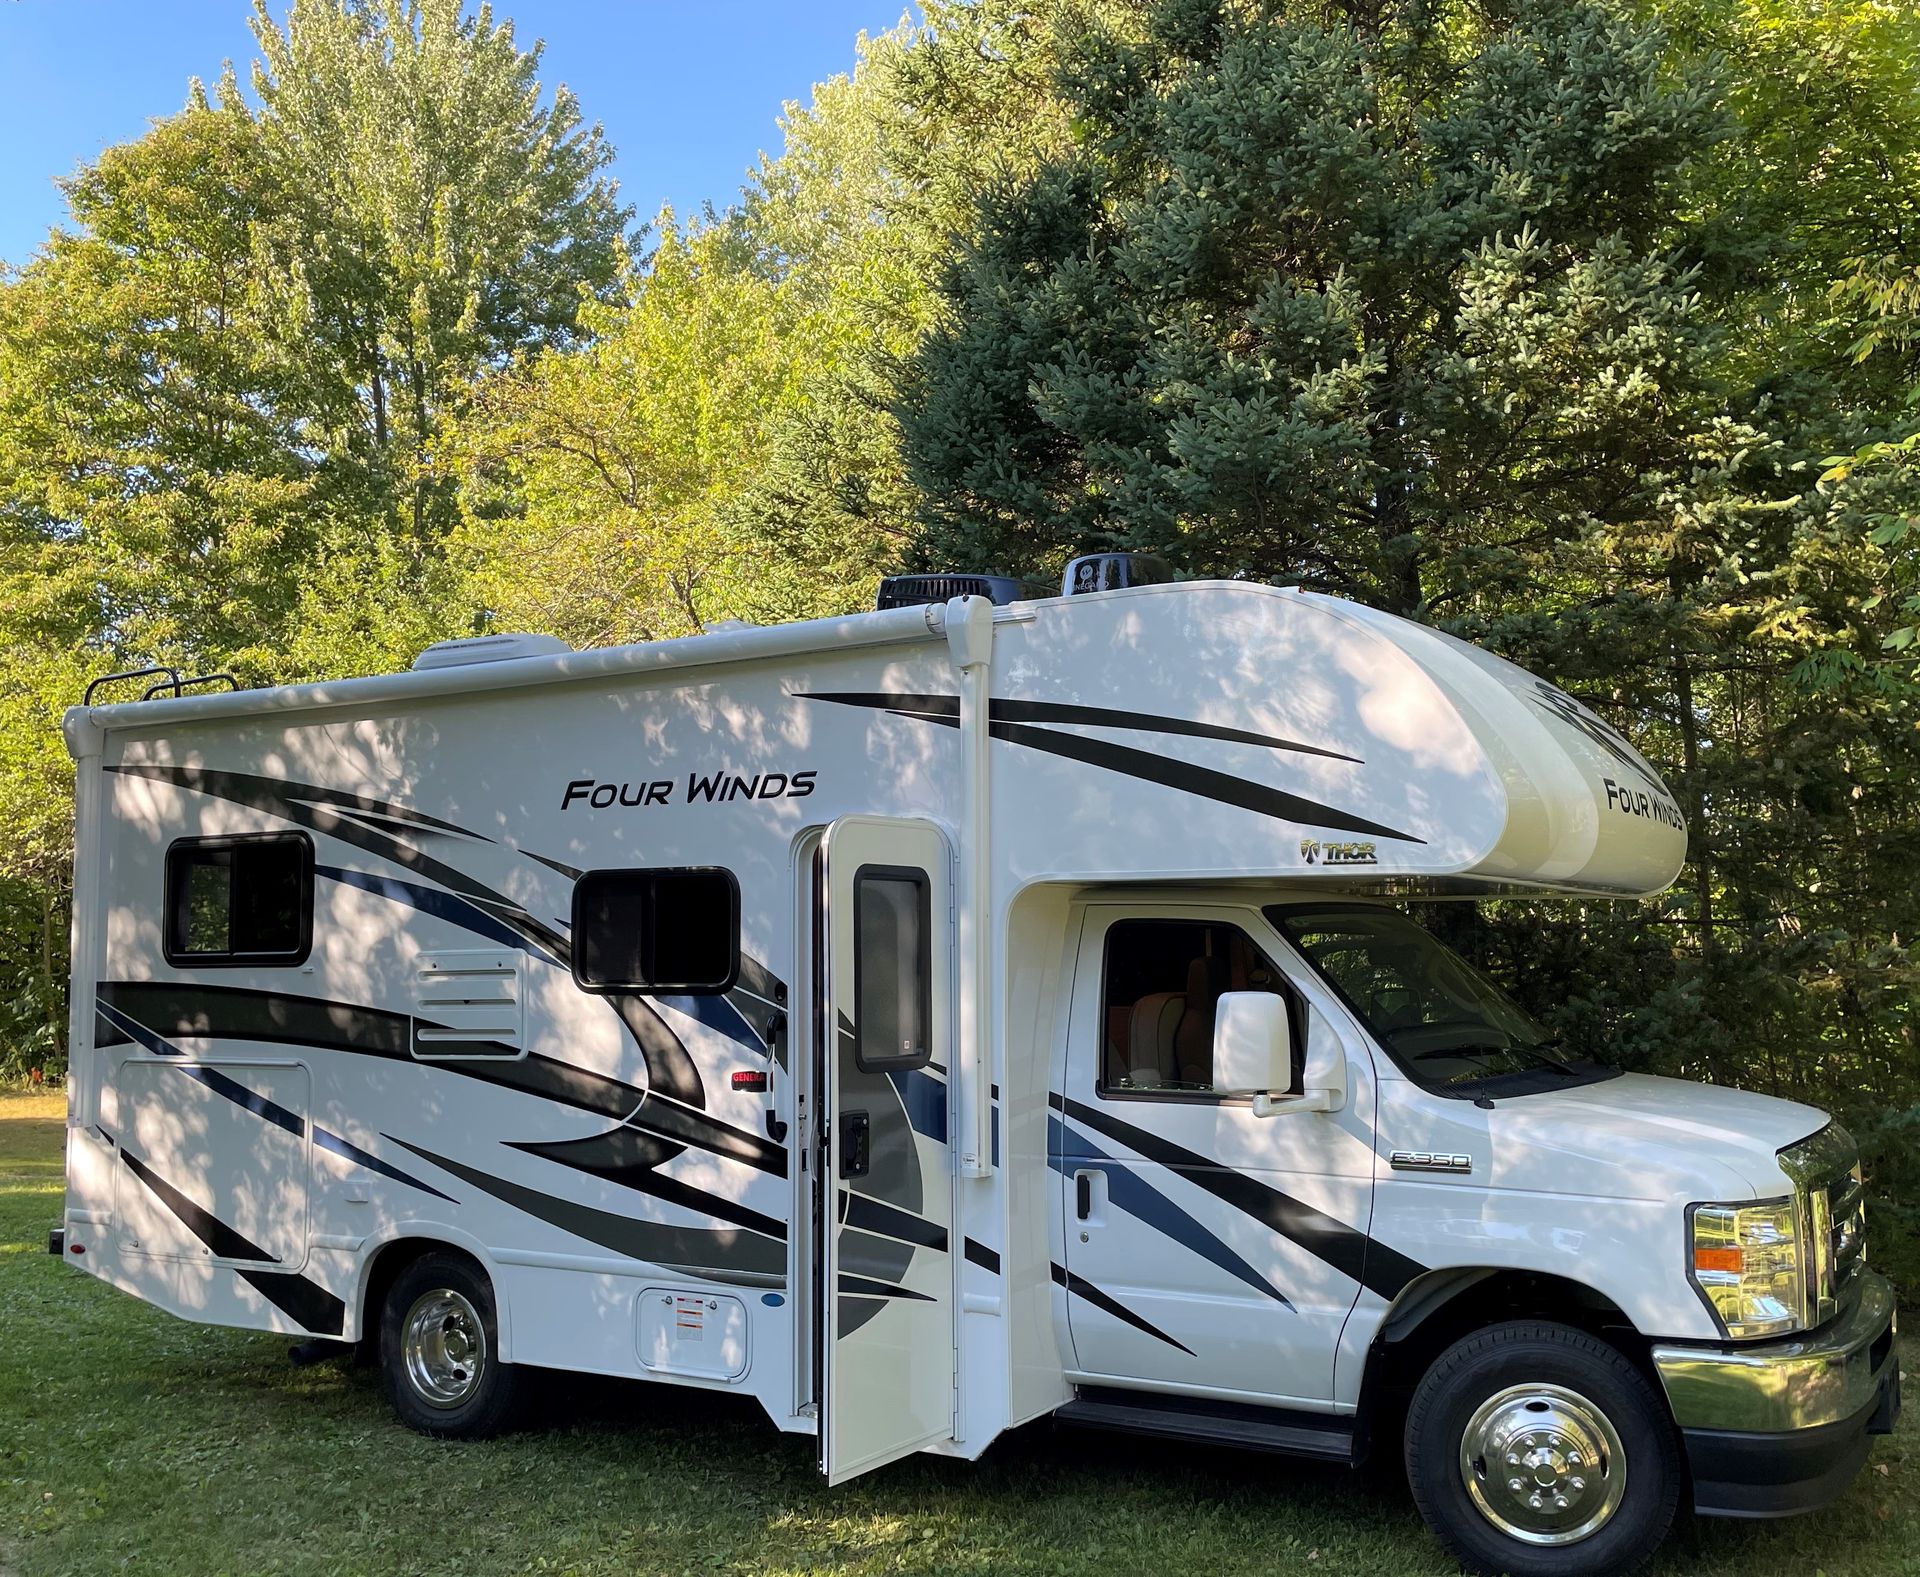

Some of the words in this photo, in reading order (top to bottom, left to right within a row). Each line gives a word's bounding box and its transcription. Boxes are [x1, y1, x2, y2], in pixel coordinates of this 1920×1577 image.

[561, 780, 674, 810] FOUR
[688, 770, 817, 803] WINDS
[1603, 778, 1650, 818] FOUR
[1648, 790, 1682, 831] WINDS
[1322, 842, 1377, 860] THOR
